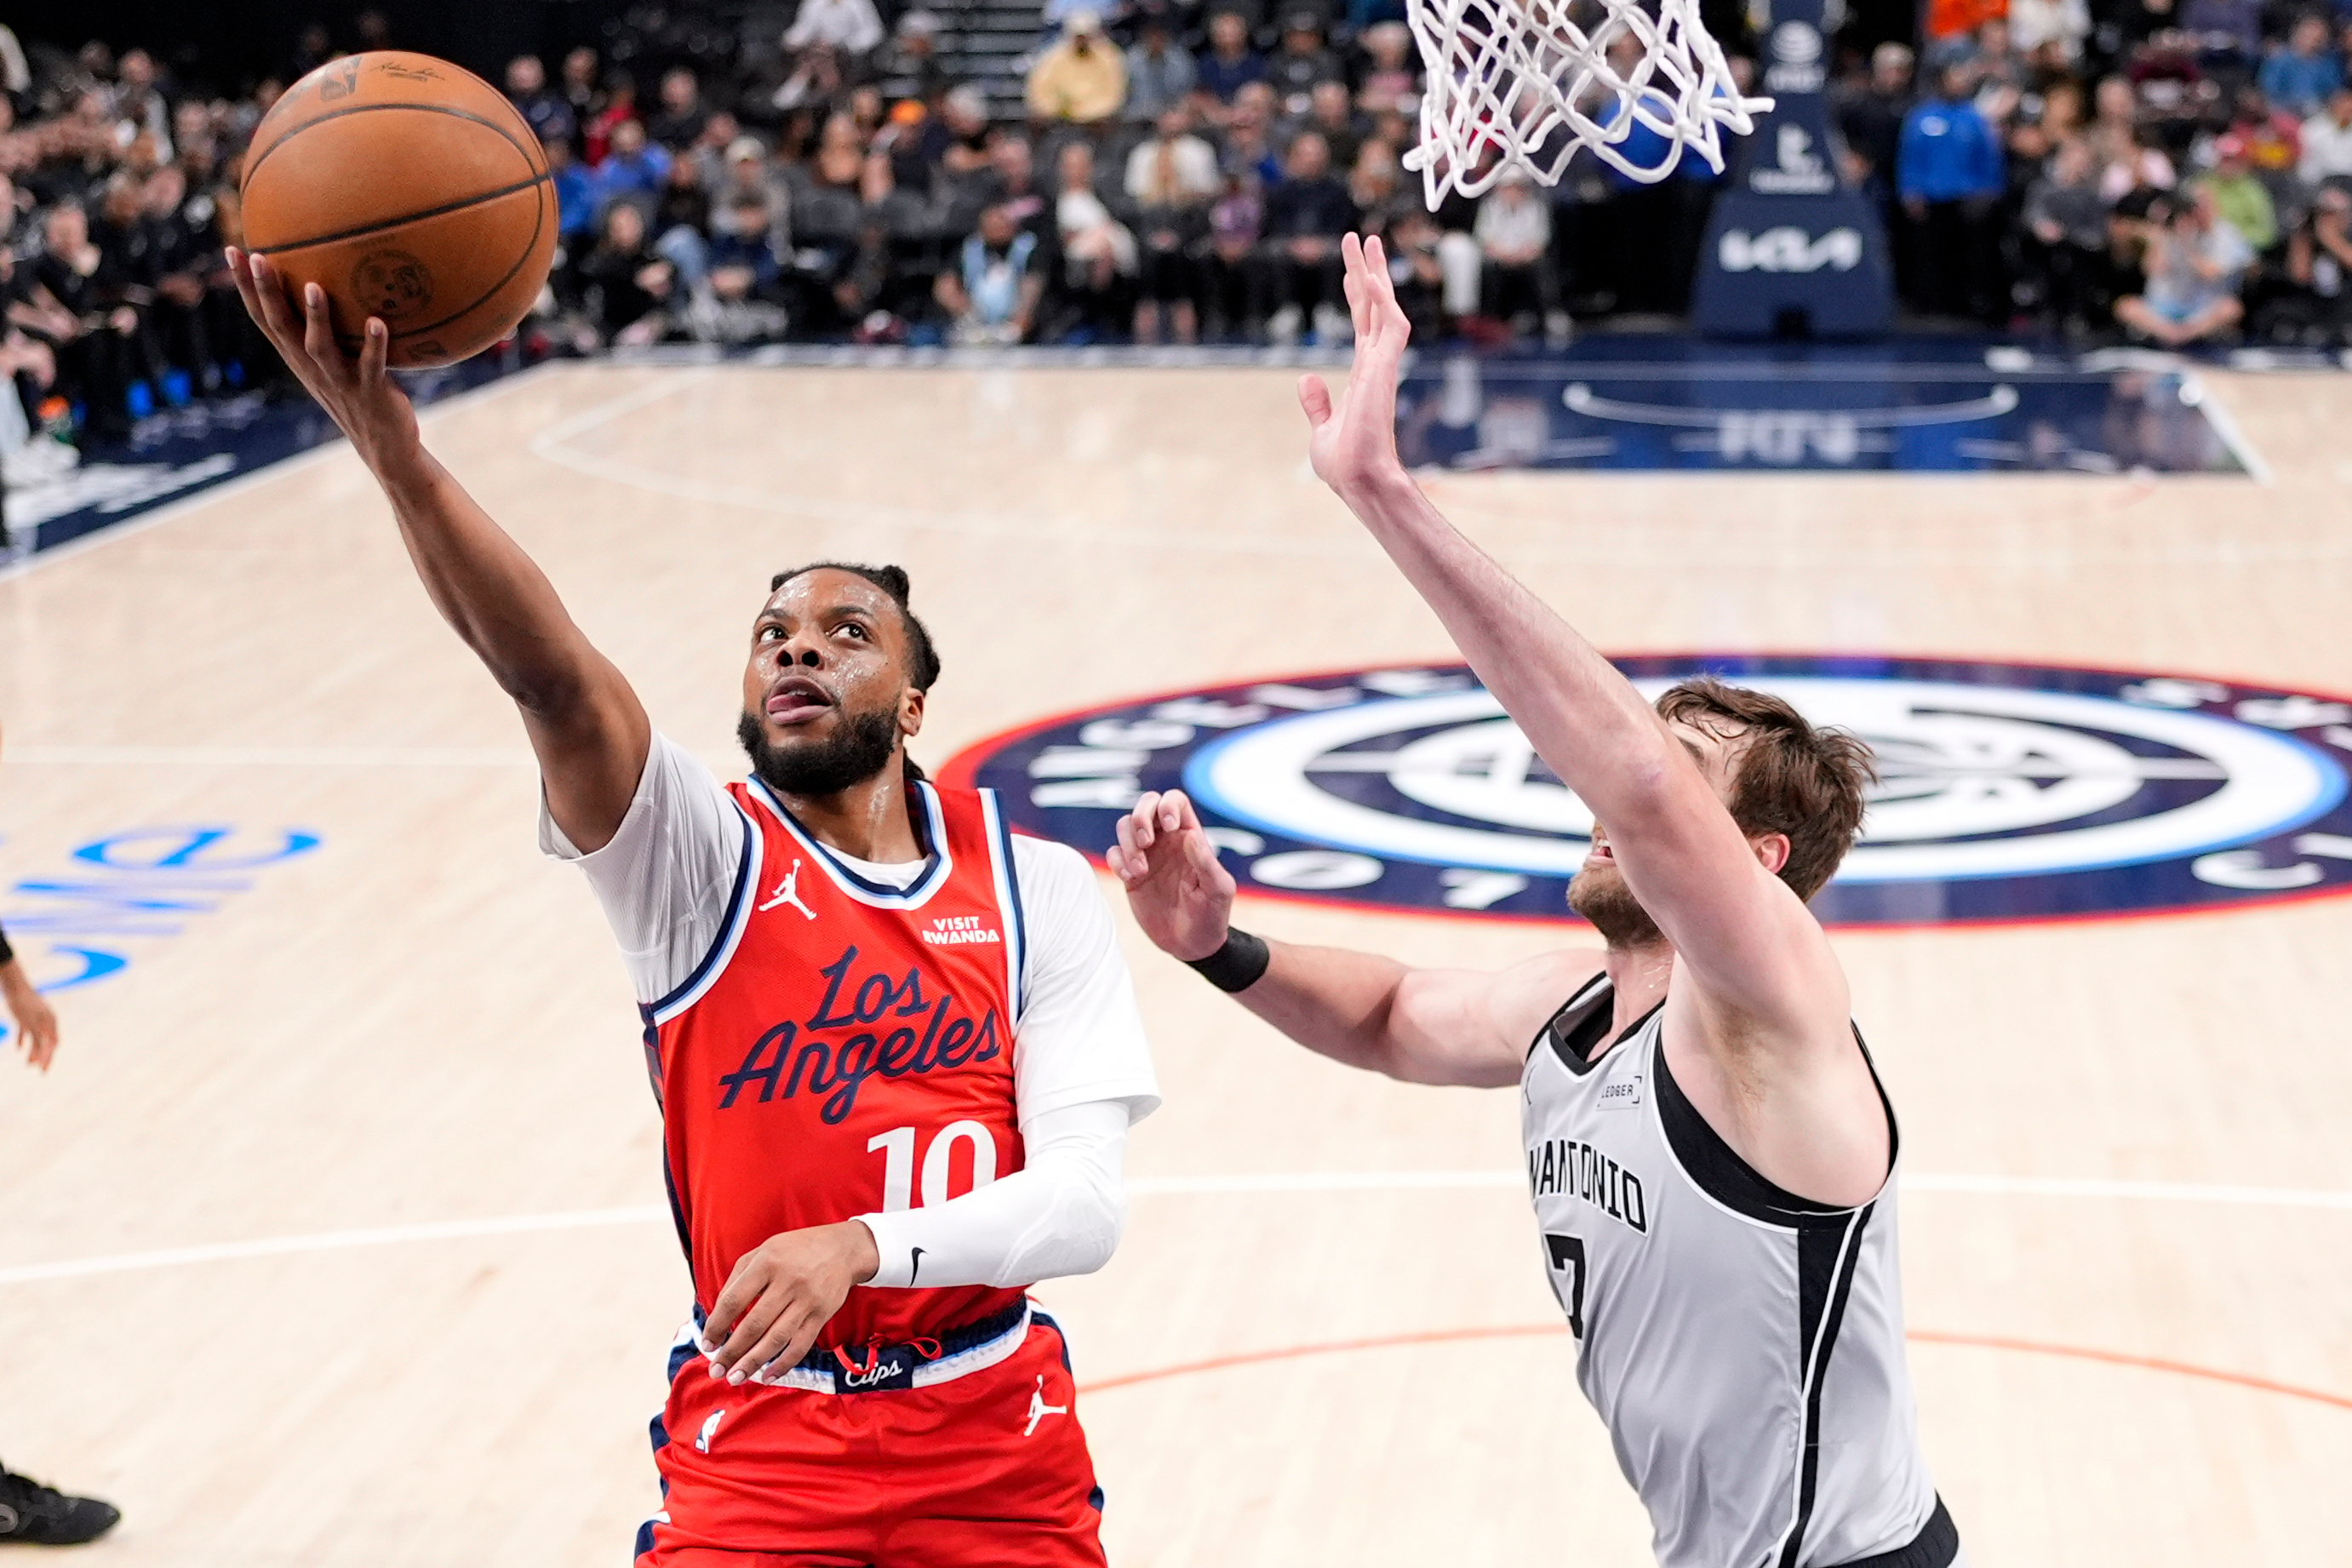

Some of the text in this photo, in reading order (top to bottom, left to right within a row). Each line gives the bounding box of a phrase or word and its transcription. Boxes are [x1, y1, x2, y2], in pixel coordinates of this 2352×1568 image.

[921, 929, 1001, 945] RWANDA
[932, 916, 980, 931] VISIT
[807, 944, 931, 1031] Los
[718, 995, 1001, 1125] Angeles
[867, 1119, 998, 1214] 10
[1543, 1233, 1587, 1341] 7
